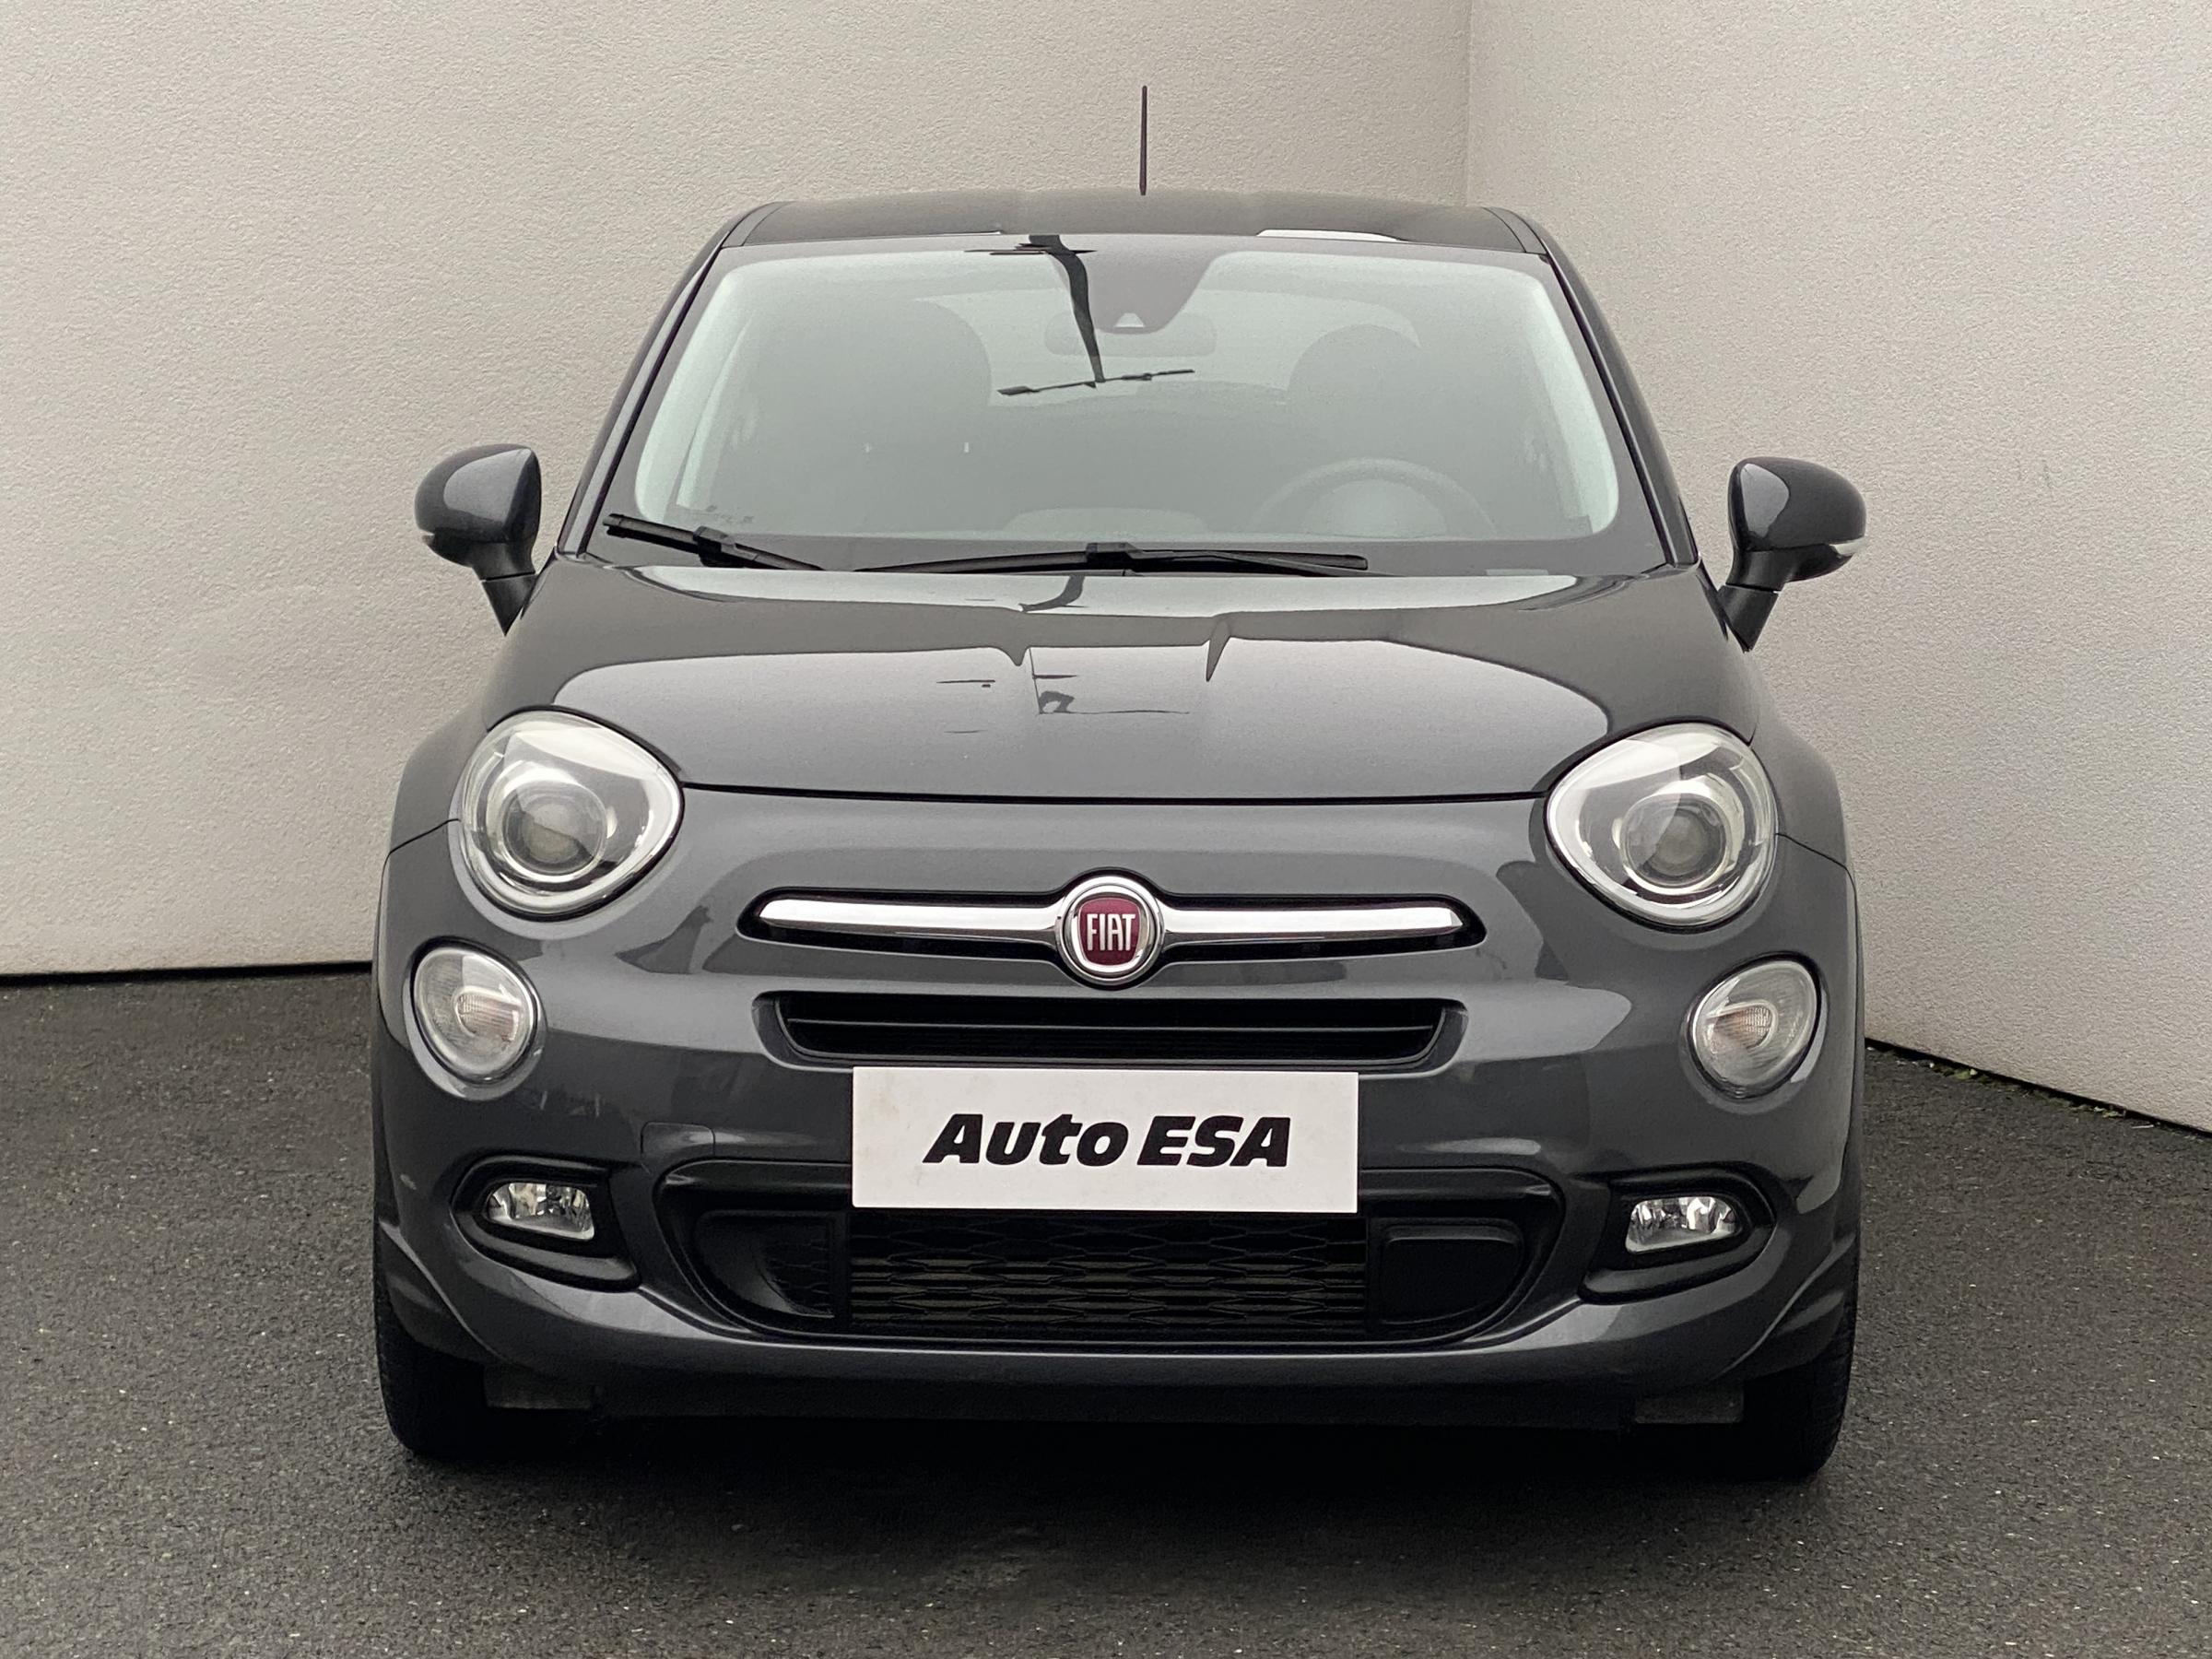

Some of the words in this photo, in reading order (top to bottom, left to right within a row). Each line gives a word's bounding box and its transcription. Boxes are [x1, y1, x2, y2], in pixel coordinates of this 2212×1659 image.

[1086, 913, 1136, 951] FIAT
[922, 1113, 1129, 1167] Auto
[1136, 1115, 1291, 1168] ESA
